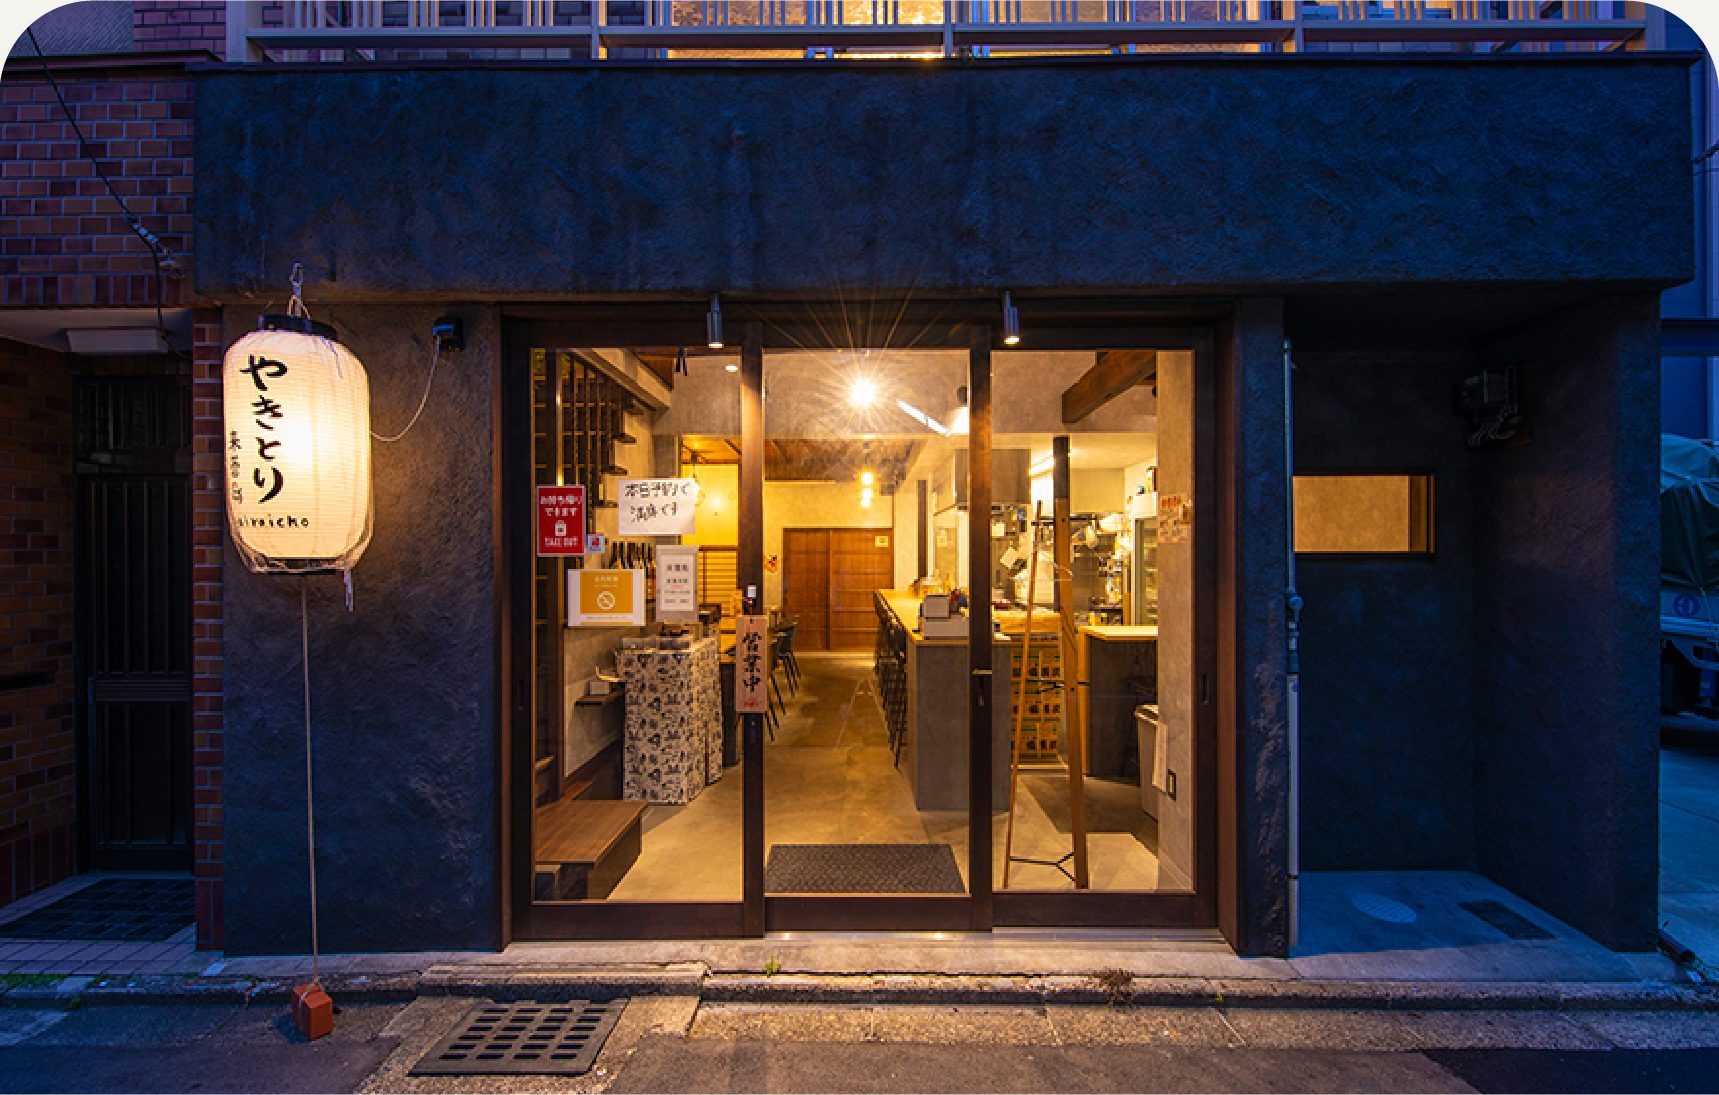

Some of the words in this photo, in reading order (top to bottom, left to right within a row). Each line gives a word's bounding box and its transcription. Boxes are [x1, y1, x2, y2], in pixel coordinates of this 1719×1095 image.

[239, 353, 289, 504] やきとり
[544, 537, 562, 547] TAKE
[563, 537, 577, 547] OUT
[742, 631, 763, 693] 営業中
